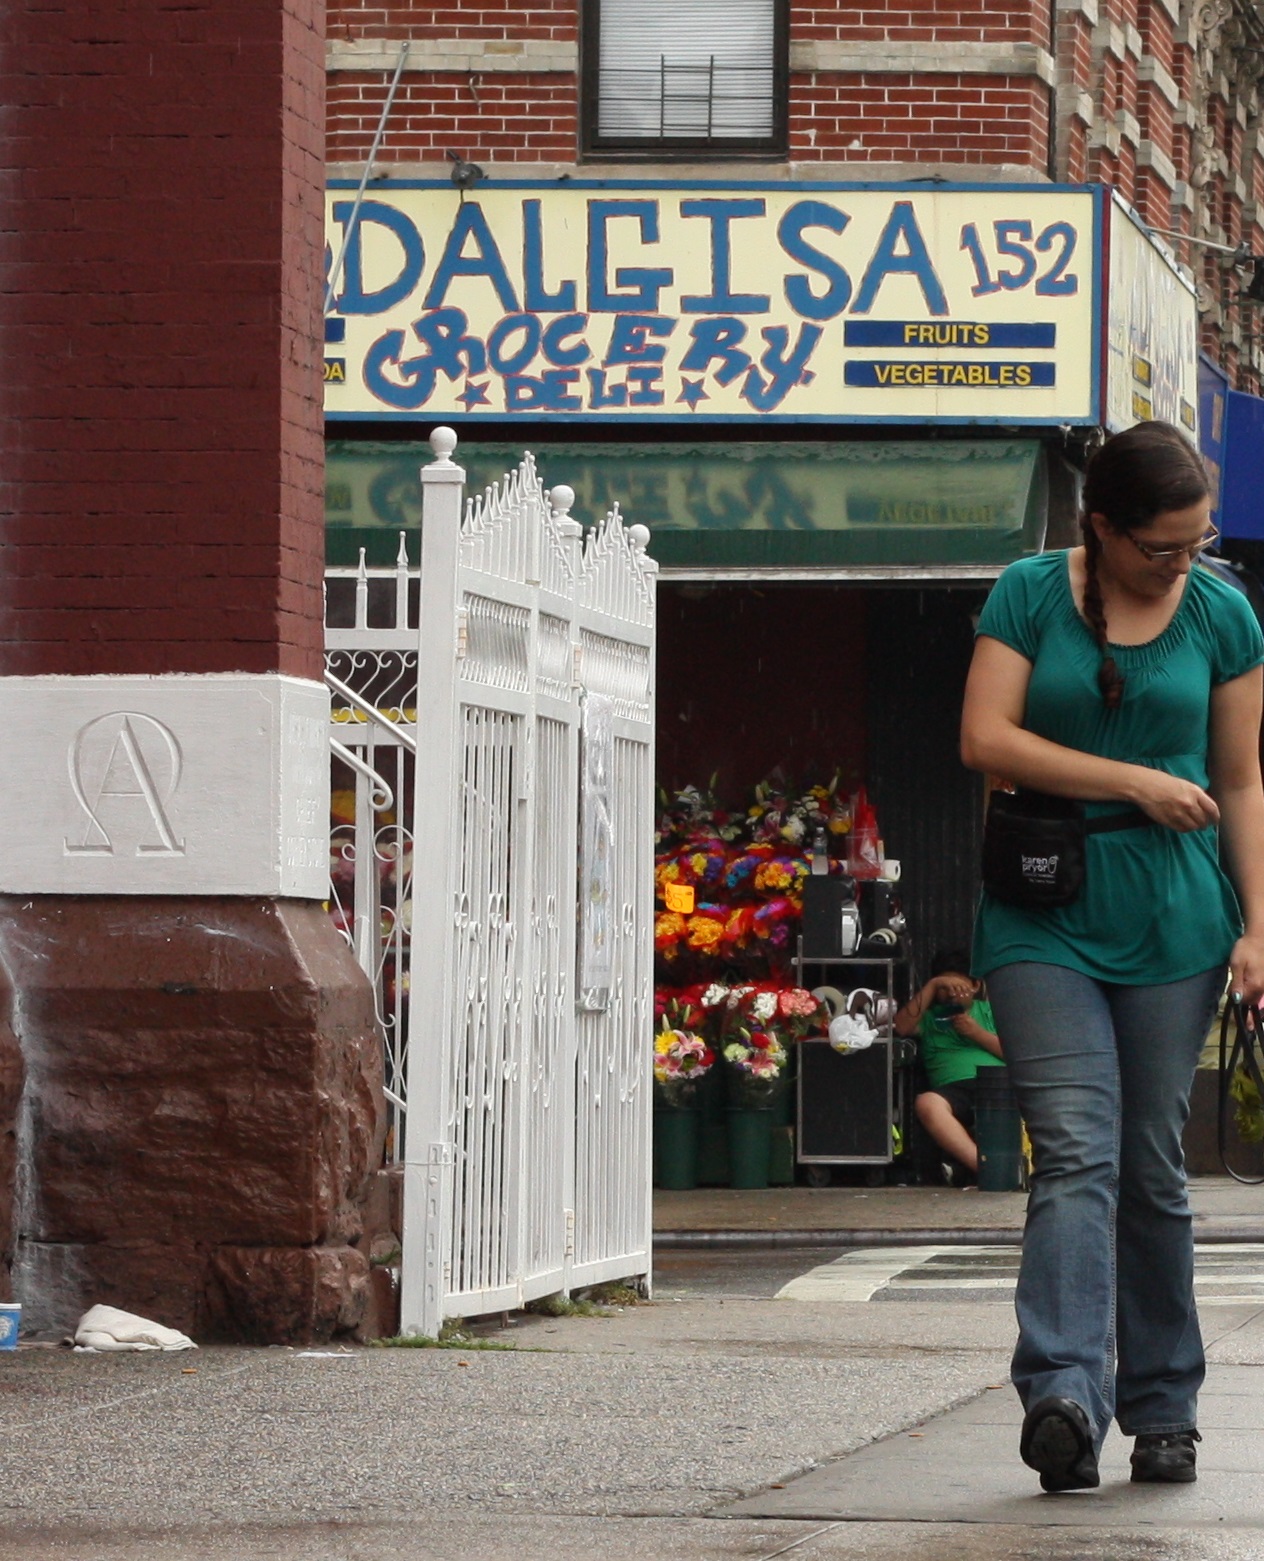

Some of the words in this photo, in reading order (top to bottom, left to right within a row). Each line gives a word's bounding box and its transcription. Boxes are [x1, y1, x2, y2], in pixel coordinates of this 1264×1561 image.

[959, 219, 1078, 298] 152
[904, 324, 990, 344] FRUITS
[362, 306, 824, 413] GROCERY
[874, 364, 1031, 385] VEGETABLES
[501, 366, 665, 412] DELI
[1021, 854, 1048, 865] karen
[1022, 863, 1049, 873] pryor
